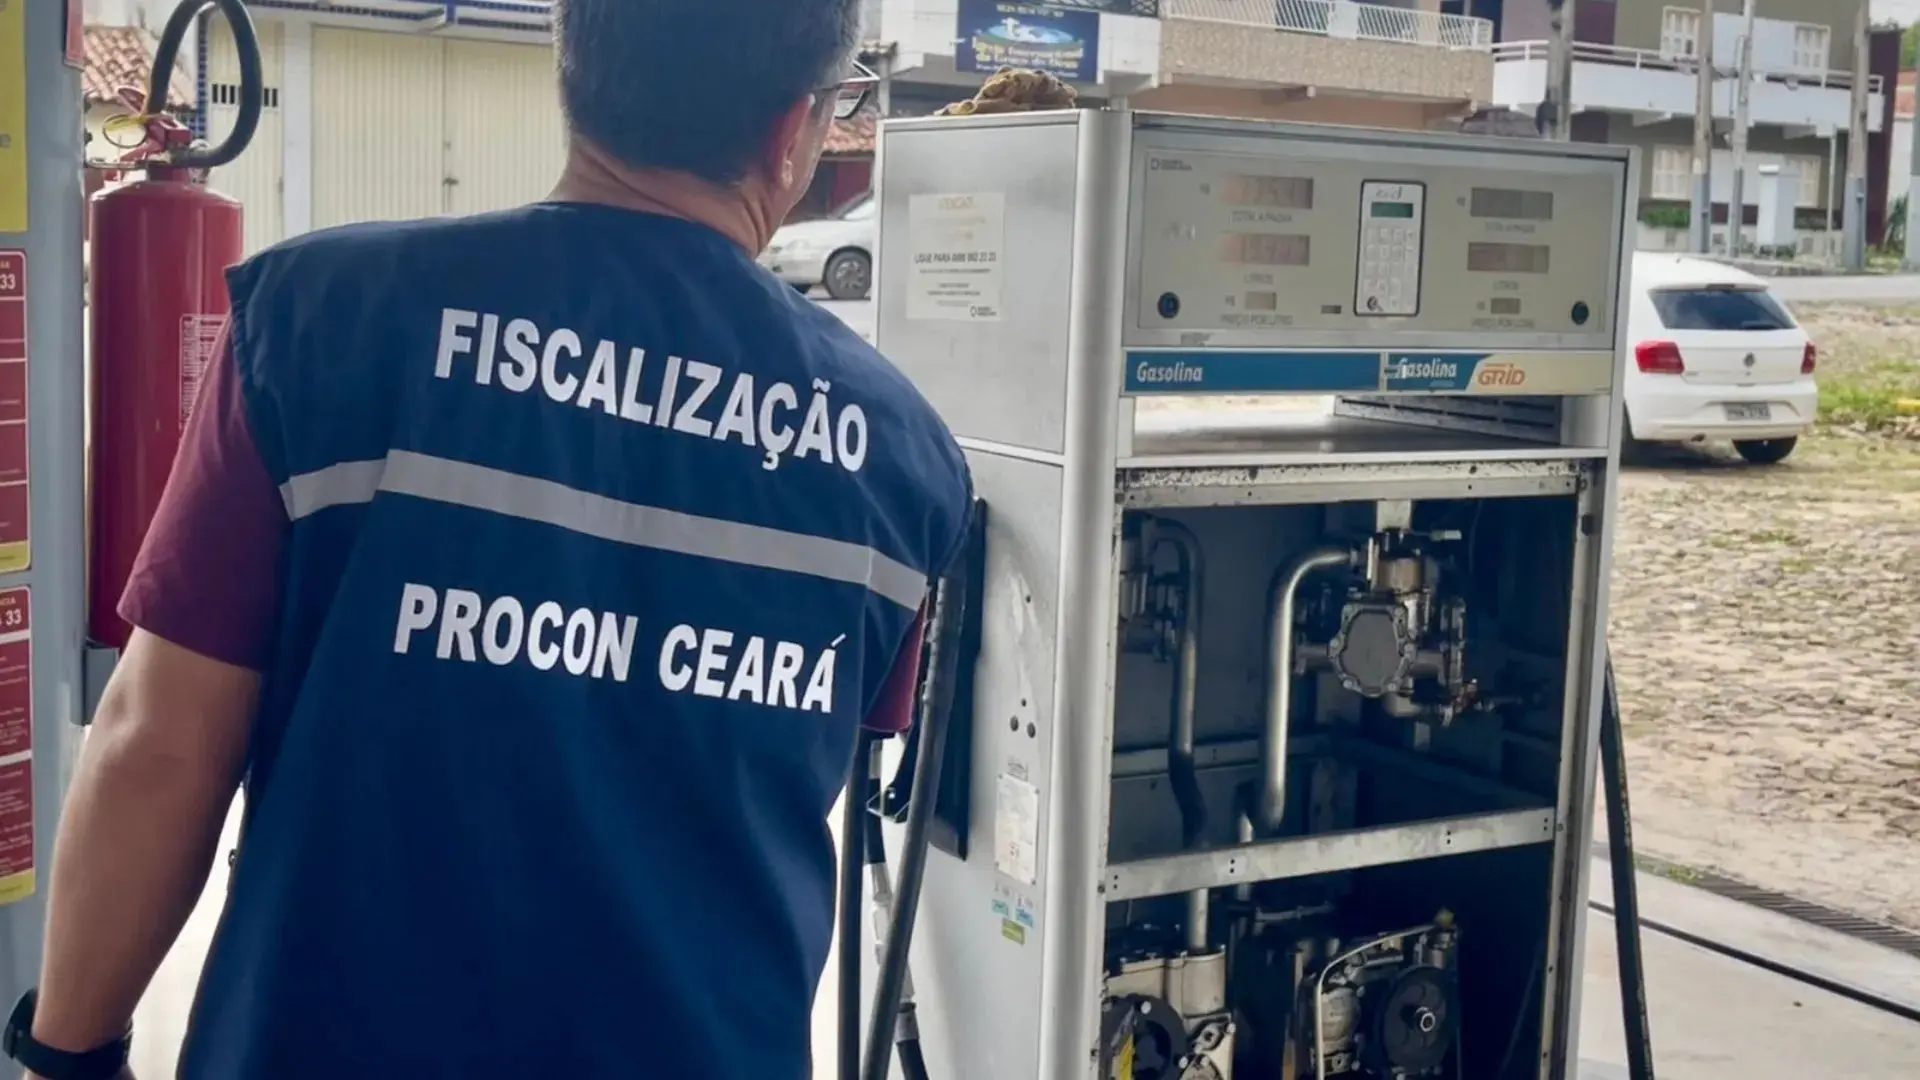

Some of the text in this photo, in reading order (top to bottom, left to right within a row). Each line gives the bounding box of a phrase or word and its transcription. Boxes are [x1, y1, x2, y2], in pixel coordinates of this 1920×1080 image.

[435, 307, 868, 472] FISCALIZAÇÃO
[1137, 361, 1203, 383] Gasolina
[1397, 357, 1458, 380] Gasolina
[394, 582, 847, 714] PROCON CEARÁ
